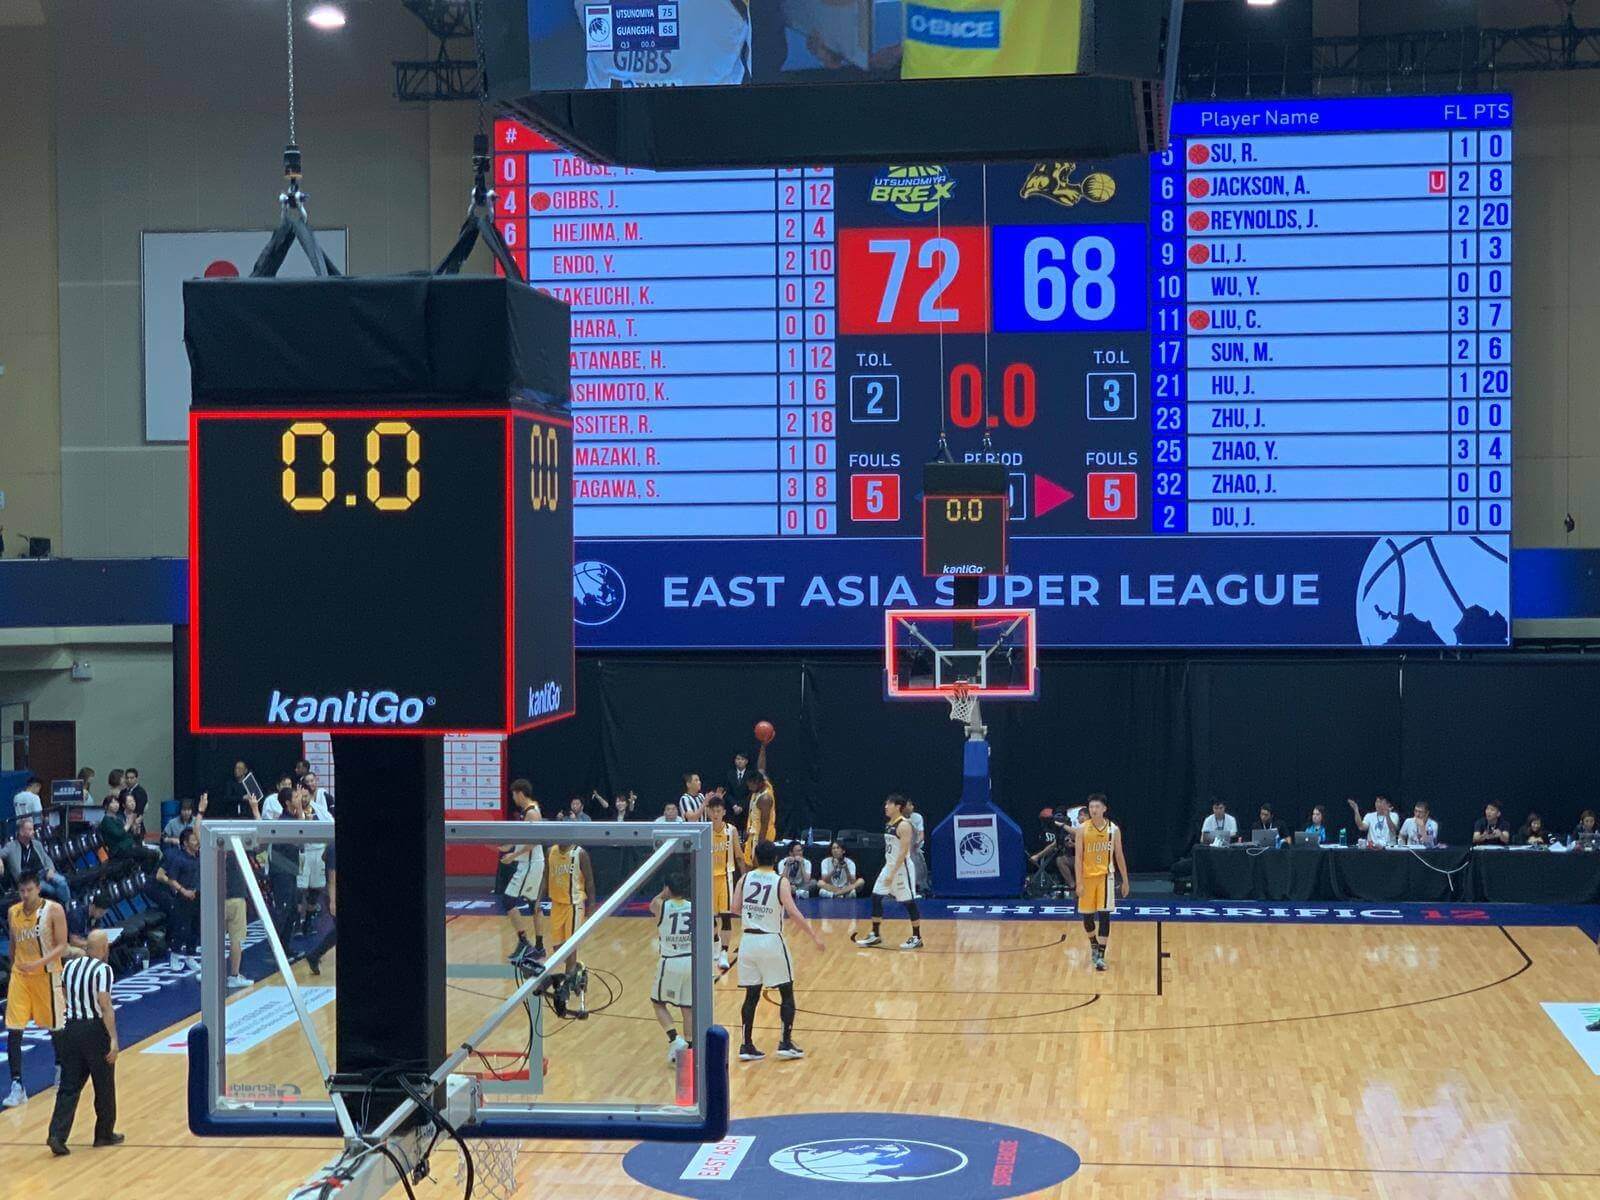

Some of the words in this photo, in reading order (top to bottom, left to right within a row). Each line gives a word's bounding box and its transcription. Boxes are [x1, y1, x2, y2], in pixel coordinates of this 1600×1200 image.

[616, 8, 655, 18] UTSUNOMIYA
[662, 9, 673, 17] 75
[617, 26, 655, 35] GUANGSHA
[662, 25, 673, 34] 68
[614, 50, 672, 74] GIBBS
[1201, 111, 1260, 130] Player
[1265, 110, 1319, 125] Name
[1445, 105, 1466, 120] FL
[1474, 103, 1510, 120] PTS
[505, 127, 517, 143] #
[1210, 143, 1237, 164] SU,
[1242, 143, 1257, 162] R.
[1461, 137, 1468, 157] 1
[1490, 134, 1502, 158] 0
[504, 158, 516, 181] 0
[874, 175, 946, 187] UTSUNOMIYA
[871, 180, 956, 202] BREX
[1162, 177, 1173, 199] 6
[1210, 176, 1289, 197] JACKSON,
[1294, 175, 1310, 195] A.
[1432, 173, 1443, 190] U
[1458, 171, 1469, 192] 2
[1489, 168, 1502, 191] 8
[504, 190, 516, 213] 4
[553, 190, 604, 210] GIBBS,
[608, 190, 619, 209] J.
[785, 185, 795, 205] 2
[809, 183, 831, 206] 12
[1162, 209, 1173, 232] 8
[1211, 209, 1301, 230] REYNOLDS,
[1307, 209, 1318, 228] J.
[1458, 205, 1469, 226] 2
[1483, 203, 1508, 226] 20
[504, 223, 516, 245] 6
[553, 222, 619, 243] HIEJIMA,
[625, 222, 643, 241] M.
[785, 218, 796, 238] 2
[813, 216, 826, 239] 4
[553, 255, 598, 275] ENDO,
[604, 255, 616, 273] Y.
[785, 250, 796, 271] 2
[810, 249, 832, 271] 10
[1162, 243, 1173, 265] 9
[1211, 243, 1230, 265] LI,
[1234, 243, 1246, 262] J.
[1461, 239, 1468, 258] 1
[1489, 236, 1501, 259] 3
[868, 237, 960, 323] 72
[1023, 236, 1116, 321] 68
[1158, 276, 1180, 298] 10
[1211, 276, 1242, 297] WU,
[1247, 276, 1260, 295] Y.
[1458, 272, 1469, 293] 0
[1489, 270, 1501, 293] 0
[553, 286, 635, 306] TAKEUCHI,
[640, 286, 654, 305] K.
[786, 283, 796, 303] 0
[814, 281, 826, 304] 2
[626, 318, 638, 337] T.
[786, 316, 796, 336] 0
[814, 313, 826, 336] 0
[1158, 308, 1179, 331] 11
[1211, 309, 1241, 330] LIU,
[1247, 309, 1261, 328] C.
[1458, 306, 1469, 326] 3
[1489, 303, 1501, 326] 7
[651, 350, 666, 369] H.
[788, 348, 796, 368] 1
[811, 346, 833, 369] 12
[856, 353, 892, 367] T.O.L
[1093, 350, 1130, 364] T.O.L
[1158, 341, 1180, 363] 17
[1211, 342, 1249, 362] SUN,
[1254, 342, 1273, 362] M.
[1458, 339, 1469, 360] 2
[1489, 337, 1501, 360] 6
[655, 382, 669, 401] K.
[788, 381, 796, 400] 1
[815, 378, 826, 401] 6
[950, 363, 1036, 428] 0.0
[1103, 379, 1120, 412] 3
[1156, 374, 1179, 397] 21
[1212, 375, 1238, 396] HU,
[1243, 375, 1255, 395] J.
[1460, 373, 1468, 393] 1
[1483, 370, 1508, 393] 20
[866, 381, 884, 414] 2
[573, 415, 635, 435] SSITER,
[639, 415, 653, 433] R.
[786, 412, 797, 432] 2
[811, 410, 833, 433] 18
[1157, 407, 1181, 430] 23
[1212, 408, 1249, 429] ZHU,
[1254, 408, 1265, 427] J.
[1458, 406, 1469, 426] 0
[1489, 403, 1501, 426] 0
[646, 447, 661, 466] R.
[789, 445, 796, 465] 1
[815, 443, 827, 466] 0
[849, 454, 900, 467] FOULS
[964, 452, 1023, 466] PEROD
[1086, 452, 1138, 466] FOULS
[1157, 440, 1181, 463] 25
[1212, 441, 1260, 462] ZHAO,
[1265, 441, 1278, 461] Y.
[1458, 439, 1469, 459] 3
[1489, 437, 1502, 460] 4
[281, 421, 421, 511] 0.0
[530, 424, 558, 511] 0.0
[646, 479, 660, 498] S.
[787, 477, 797, 498] 3
[815, 476, 827, 498] 8
[1157, 473, 1181, 495] 32
[1212, 474, 1260, 495] ZHAO,
[1265, 474, 1276, 493] J.
[1458, 472, 1469, 492] 0
[1489, 470, 1501, 493] 0
[866, 480, 884, 513] 5
[1103, 479, 1121, 512] 5
[787, 510, 798, 530] 0
[815, 508, 827, 530] 0
[946, 498, 983, 522] 0.0
[1164, 506, 1175, 528] 2
[1212, 507, 1238, 528] DU,
[1243, 507, 1255, 526] J.
[1458, 505, 1469, 525] 0
[1489, 503, 1501, 526] 0
[942, 565, 984, 575] kantiGo
[664, 576, 785, 607] EAST
[801, 576, 918, 606] ASIA
[1120, 574, 1319, 606] LEAGUE
[267, 690, 425, 725] kantiGo
[528, 681, 561, 717] kantiGo
[1087, 840, 1112, 853] LIONS
[744, 882, 773, 905] 21
[669, 912, 691, 934] 13
[947, 905, 1074, 915] THE
[1421, 909, 1490, 920] 12
[698, 1157, 726, 1176] EAST
